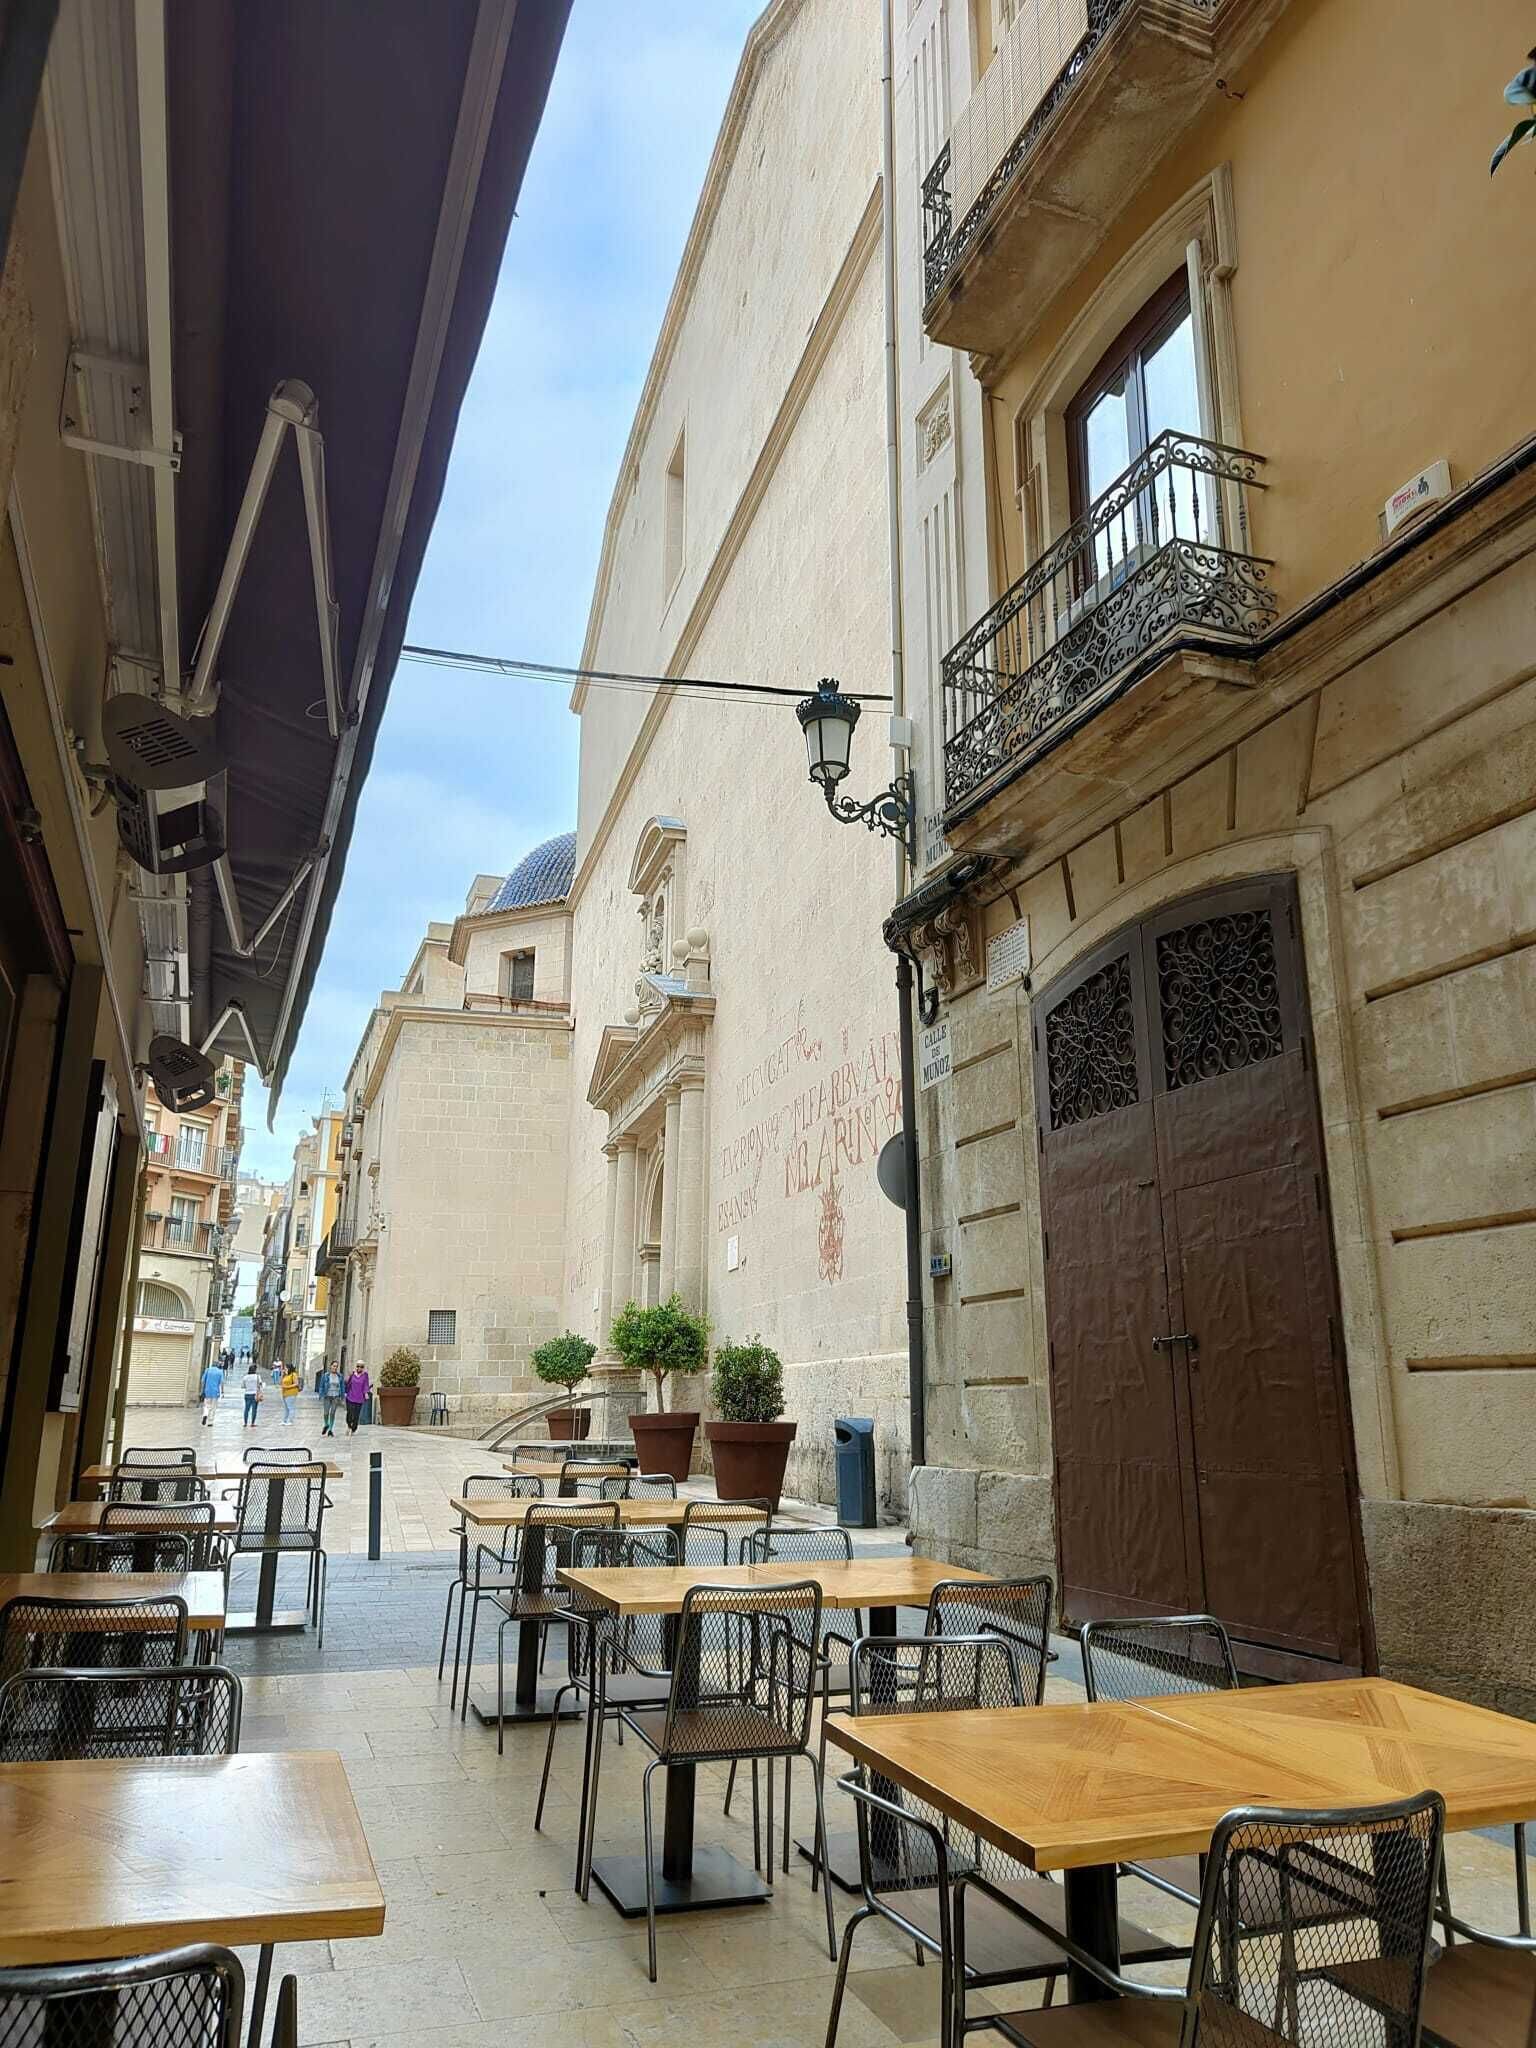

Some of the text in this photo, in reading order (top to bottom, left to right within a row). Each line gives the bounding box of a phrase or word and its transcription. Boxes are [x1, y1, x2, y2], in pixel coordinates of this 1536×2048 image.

[924, 1024, 947, 1048] CALLE
[931, 1045, 941, 1058] DE
[923, 1054, 950, 1084] MUÑOZ
